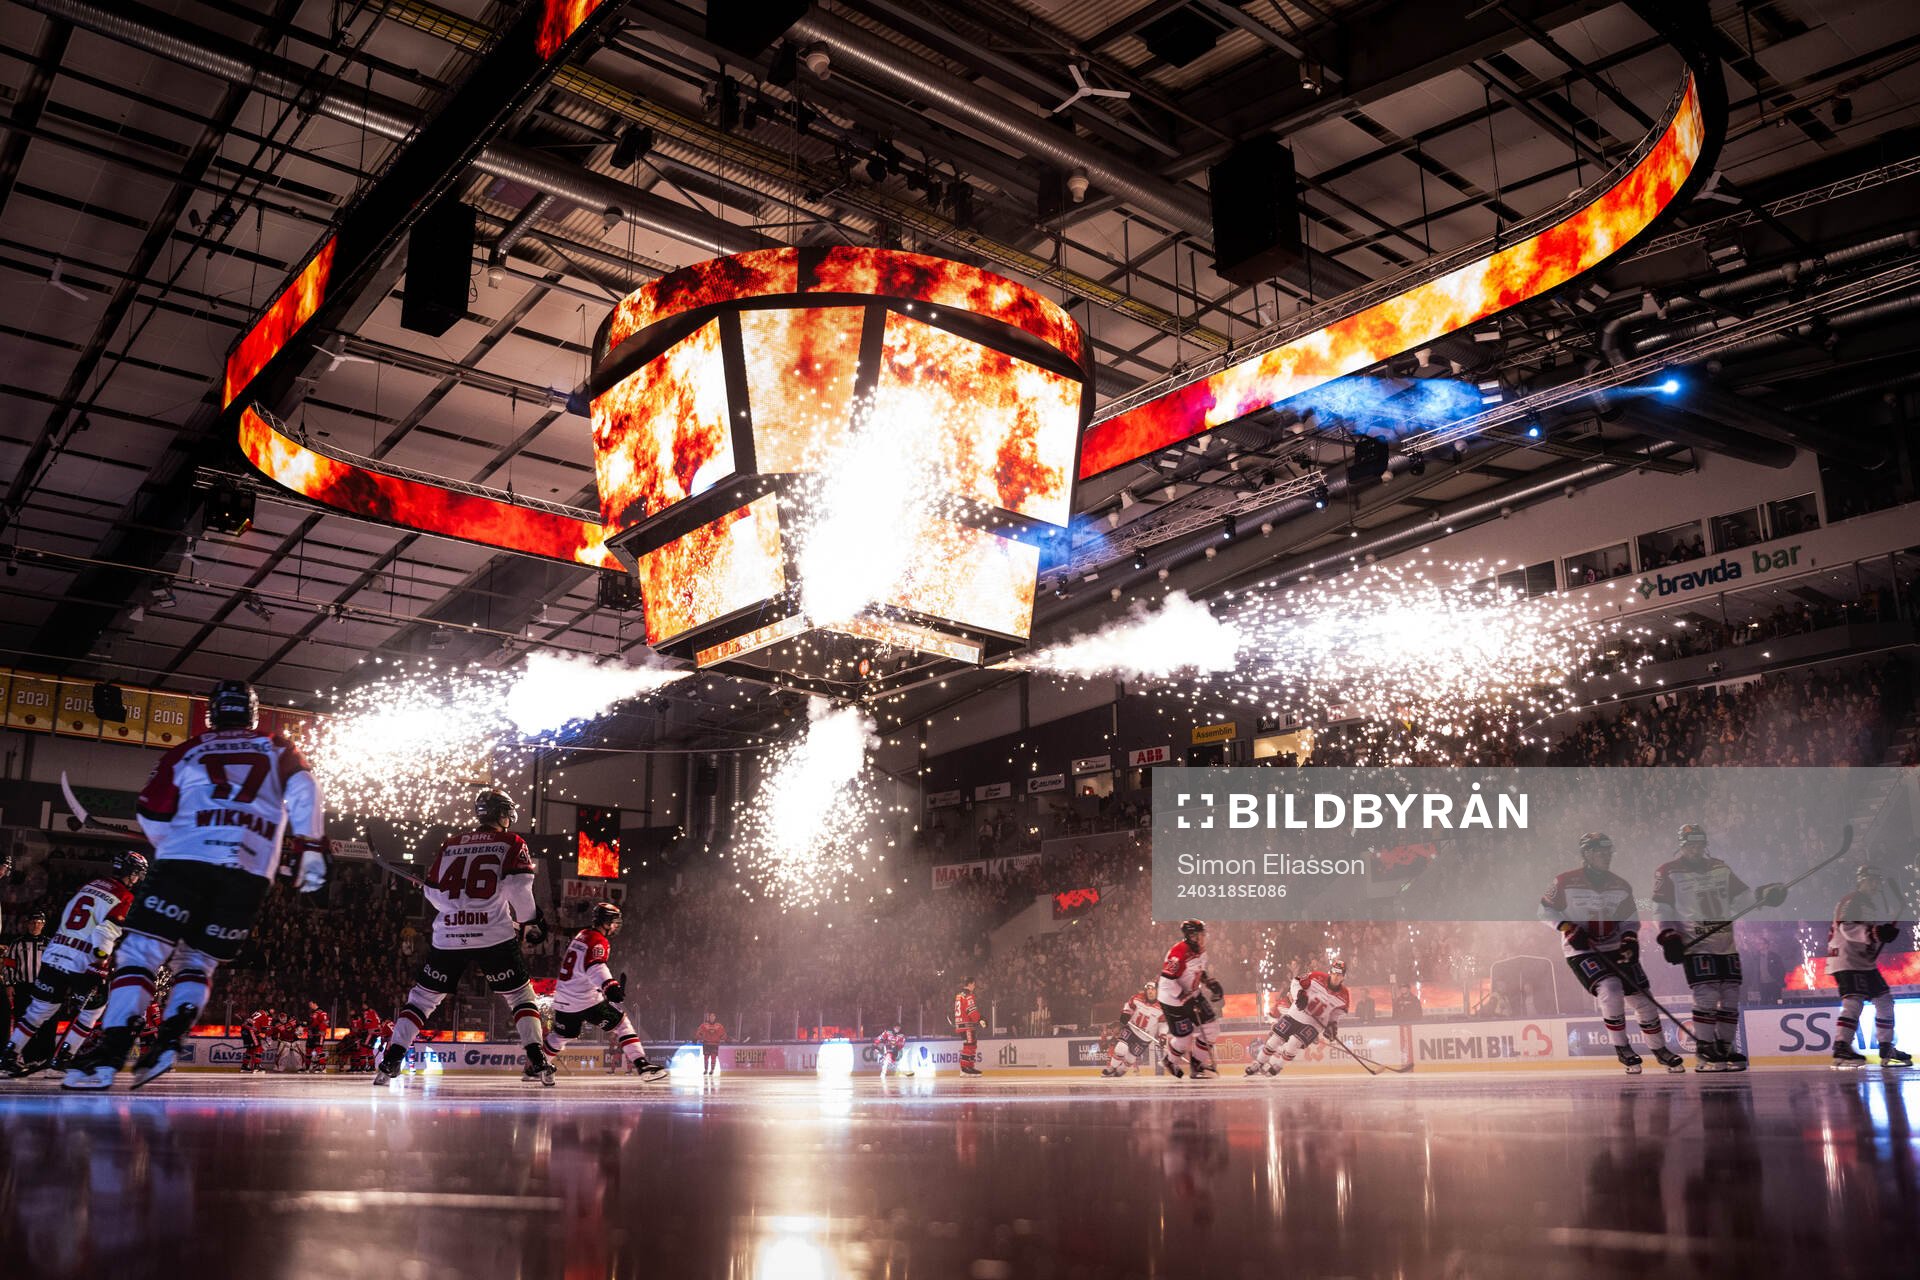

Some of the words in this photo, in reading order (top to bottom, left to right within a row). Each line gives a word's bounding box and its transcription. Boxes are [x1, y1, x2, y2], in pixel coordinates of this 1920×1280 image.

[1657, 559, 1741, 596] bravida
[1752, 544, 1803, 574] bar
[16, 690, 50, 707] 2021
[154, 709, 184, 725] 2016
[1195, 727, 1234, 740] Assemblin
[1136, 748, 1165, 765] ABB
[198, 753, 272, 804] 17
[195, 808, 279, 842] WIKMAN
[443, 844, 506, 857] MALMBERGS
[439, 854, 502, 900] 46
[65, 895, 95, 931] 6
[444, 910, 489, 926] SJÖDIN
[1418, 1036, 1483, 1061] NIEMI
[1486, 1034, 1521, 1059] BIL
[1078, 1052, 1111, 1062] UNIVERS
